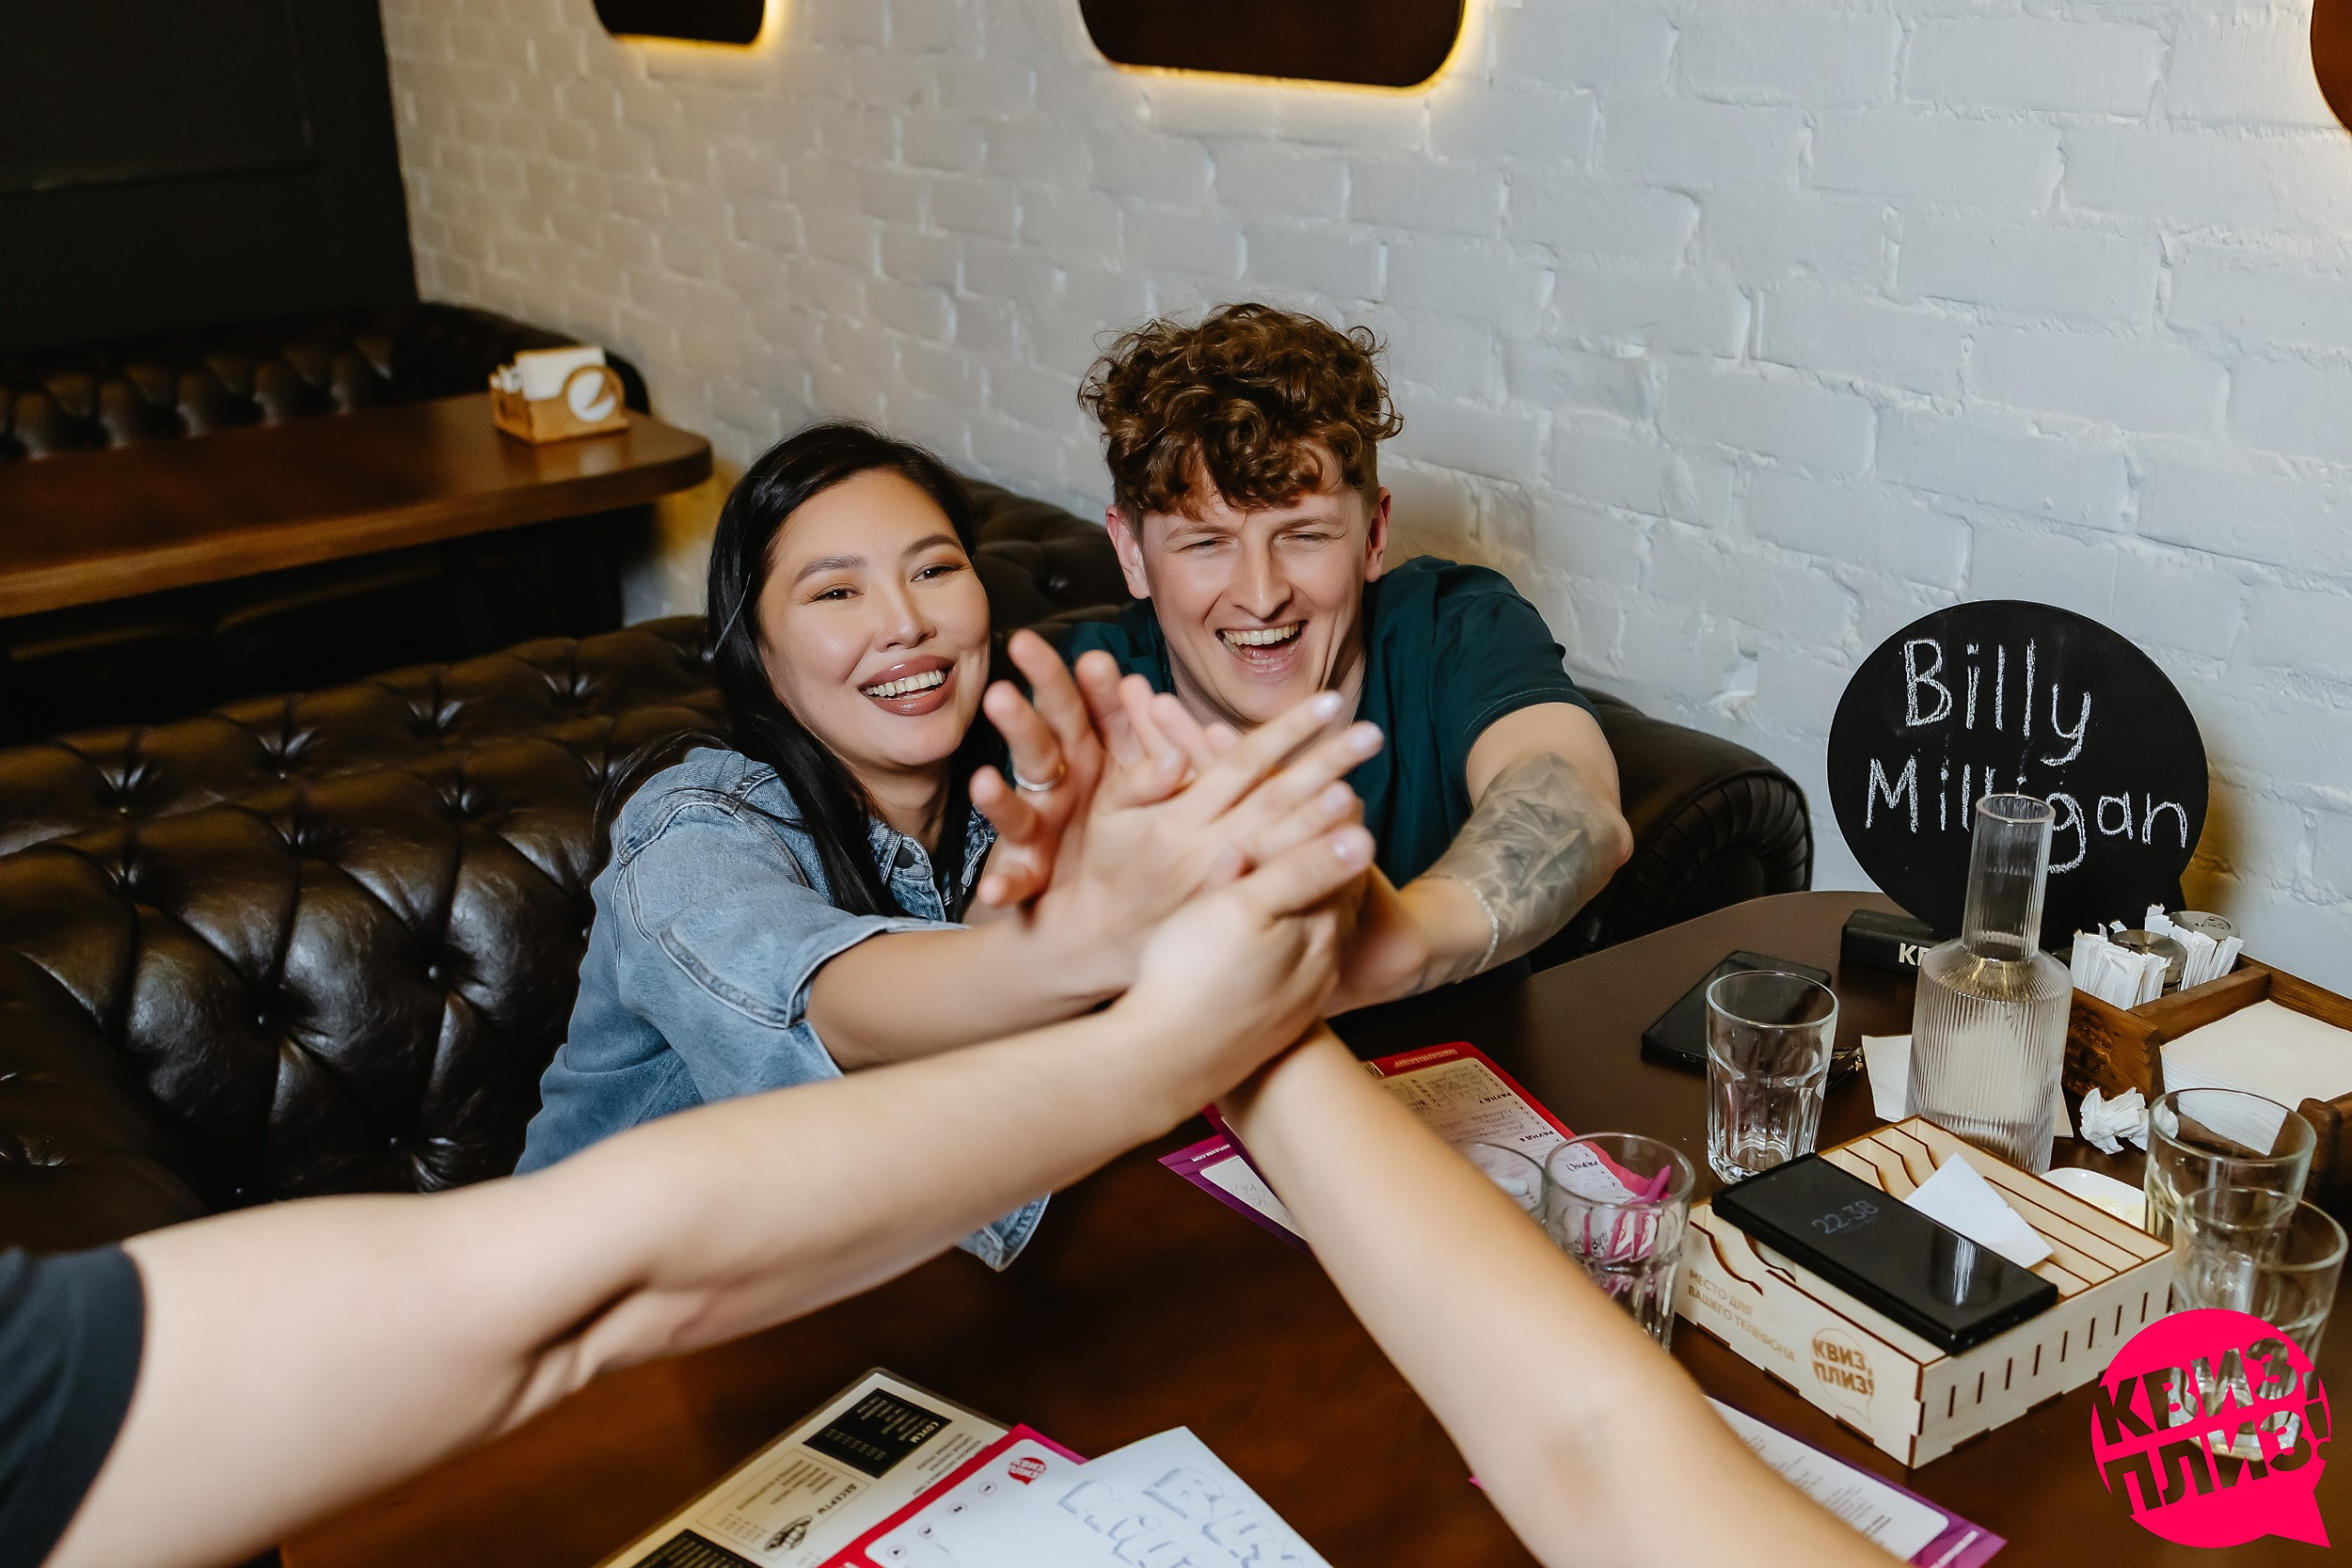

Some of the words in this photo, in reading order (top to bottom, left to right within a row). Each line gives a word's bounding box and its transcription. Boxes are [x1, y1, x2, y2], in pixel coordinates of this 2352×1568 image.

[1902, 638, 2092, 768] Billy
[1865, 753, 2188, 875] Milgan
[1689, 1285, 1733, 1321] ВАШЕГО
[1735, 1315, 1795, 1362] ТЕЛЕФОНА
[1690, 1270, 1727, 1300] МЕСТО
[1728, 1294, 1754, 1317] ДЛЯ
